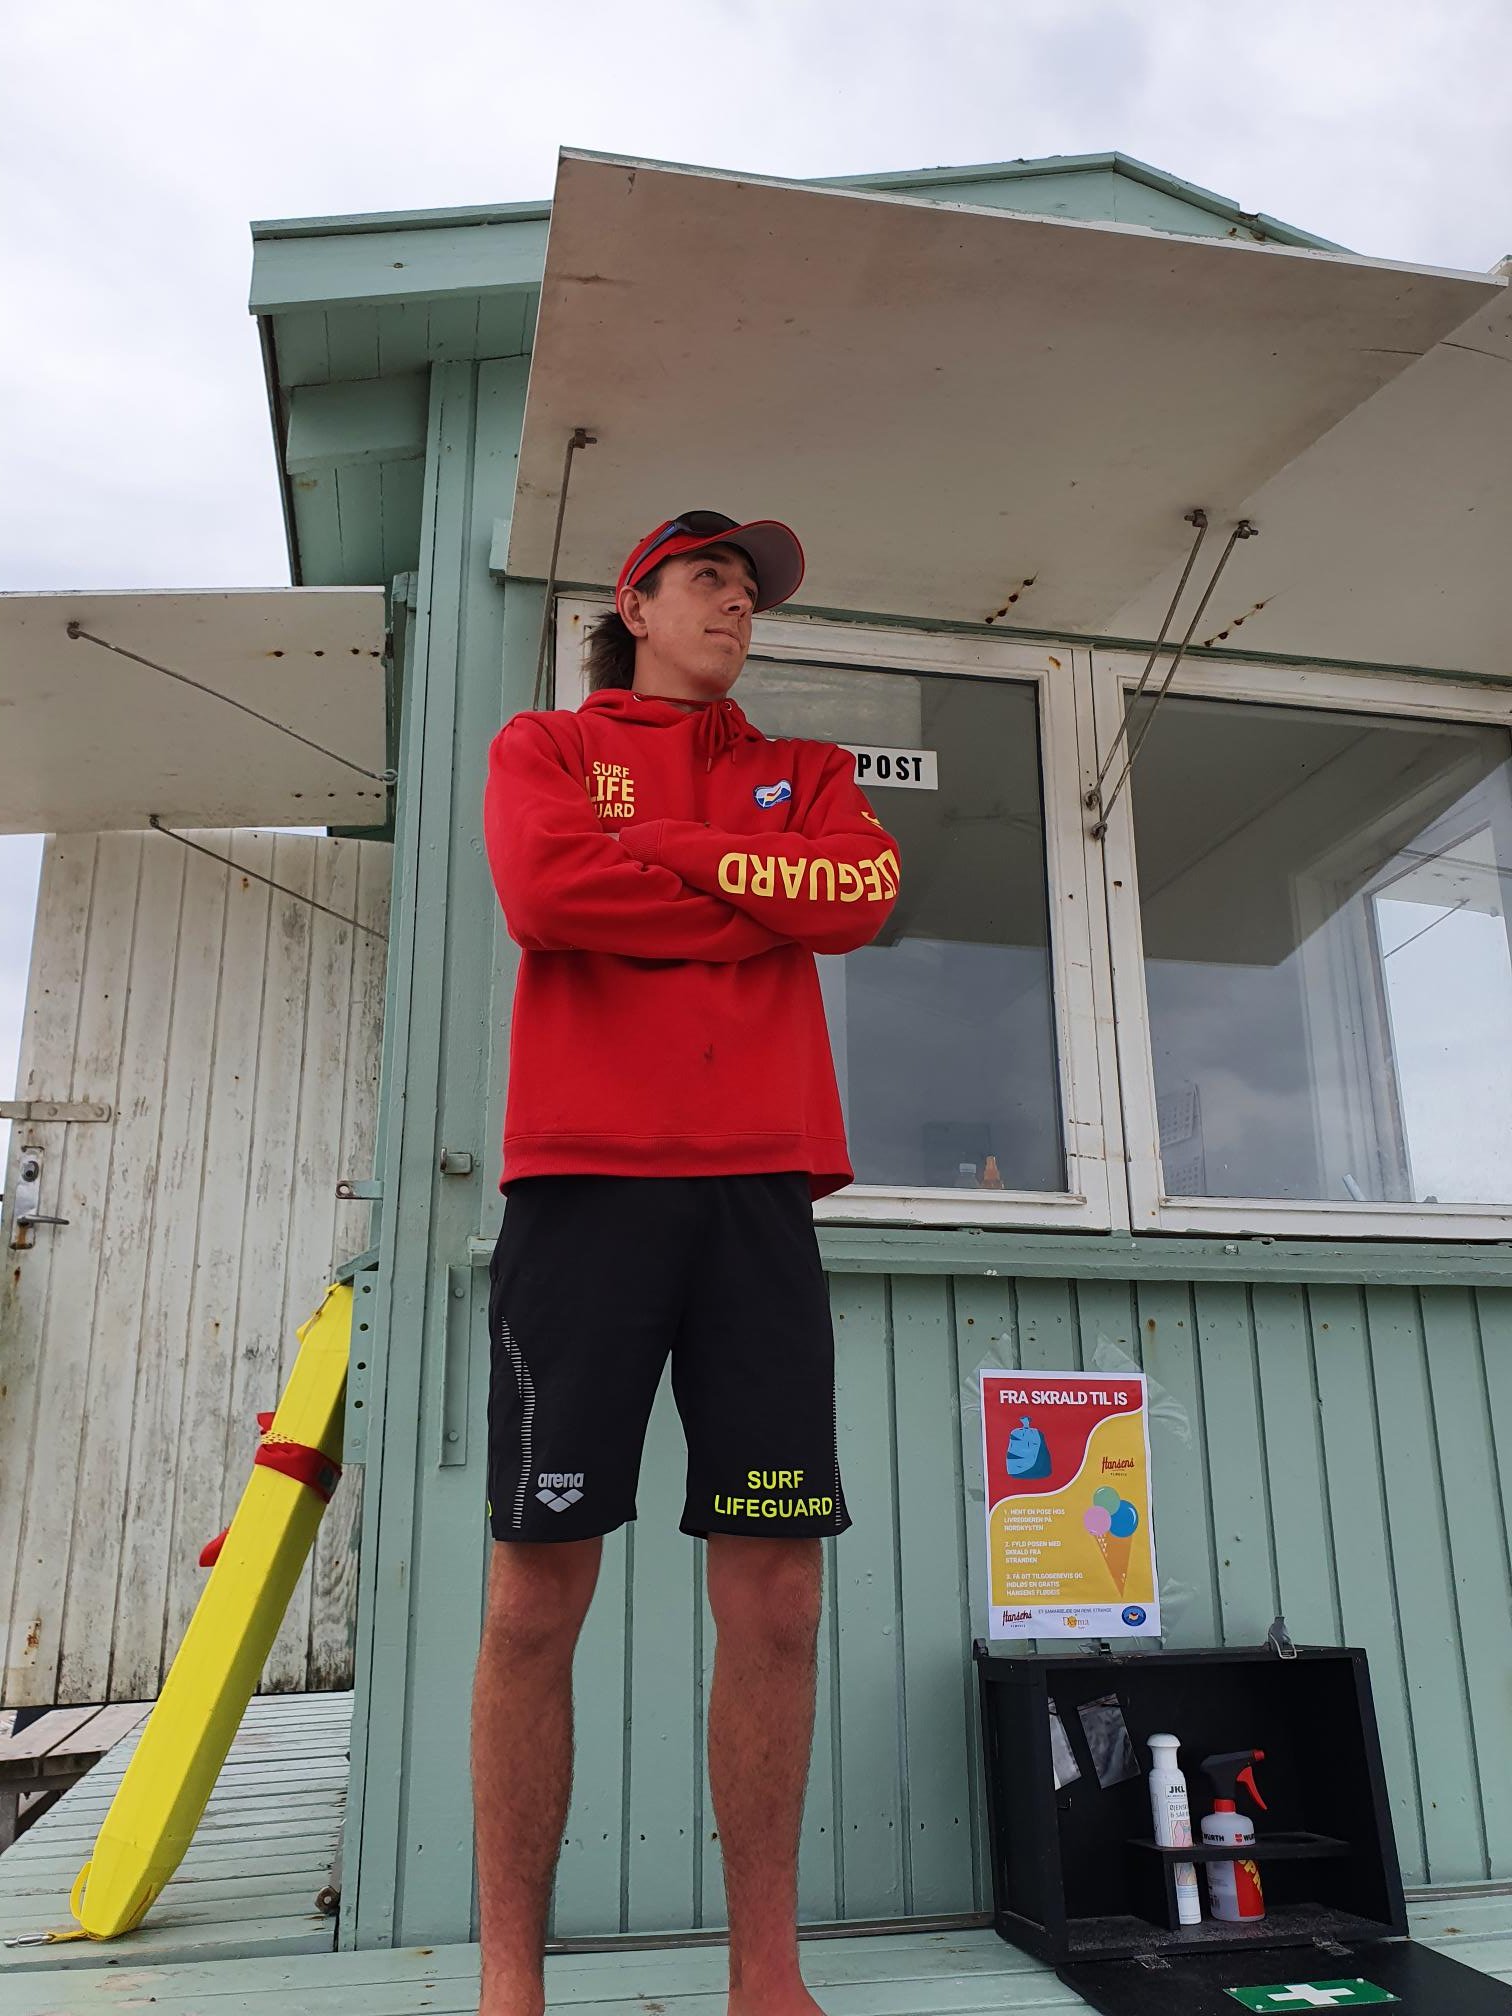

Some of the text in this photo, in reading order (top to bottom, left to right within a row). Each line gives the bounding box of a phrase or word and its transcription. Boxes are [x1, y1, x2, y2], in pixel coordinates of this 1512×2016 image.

[592, 761, 630, 778] SURF
[857, 753, 922, 782] POST
[594, 803, 635, 818] UARD
[999, 1390, 1128, 1406] FRA SKRALD TIL IS
[1101, 1456, 1135, 1474] Hansens
[537, 1473, 585, 1488] arena
[747, 1470, 804, 1489] SURF
[714, 1494, 833, 1518] LIFEGUARD
[1002, 1609, 1033, 1627] Hansens
[1168, 1785, 1186, 1794] JKL
